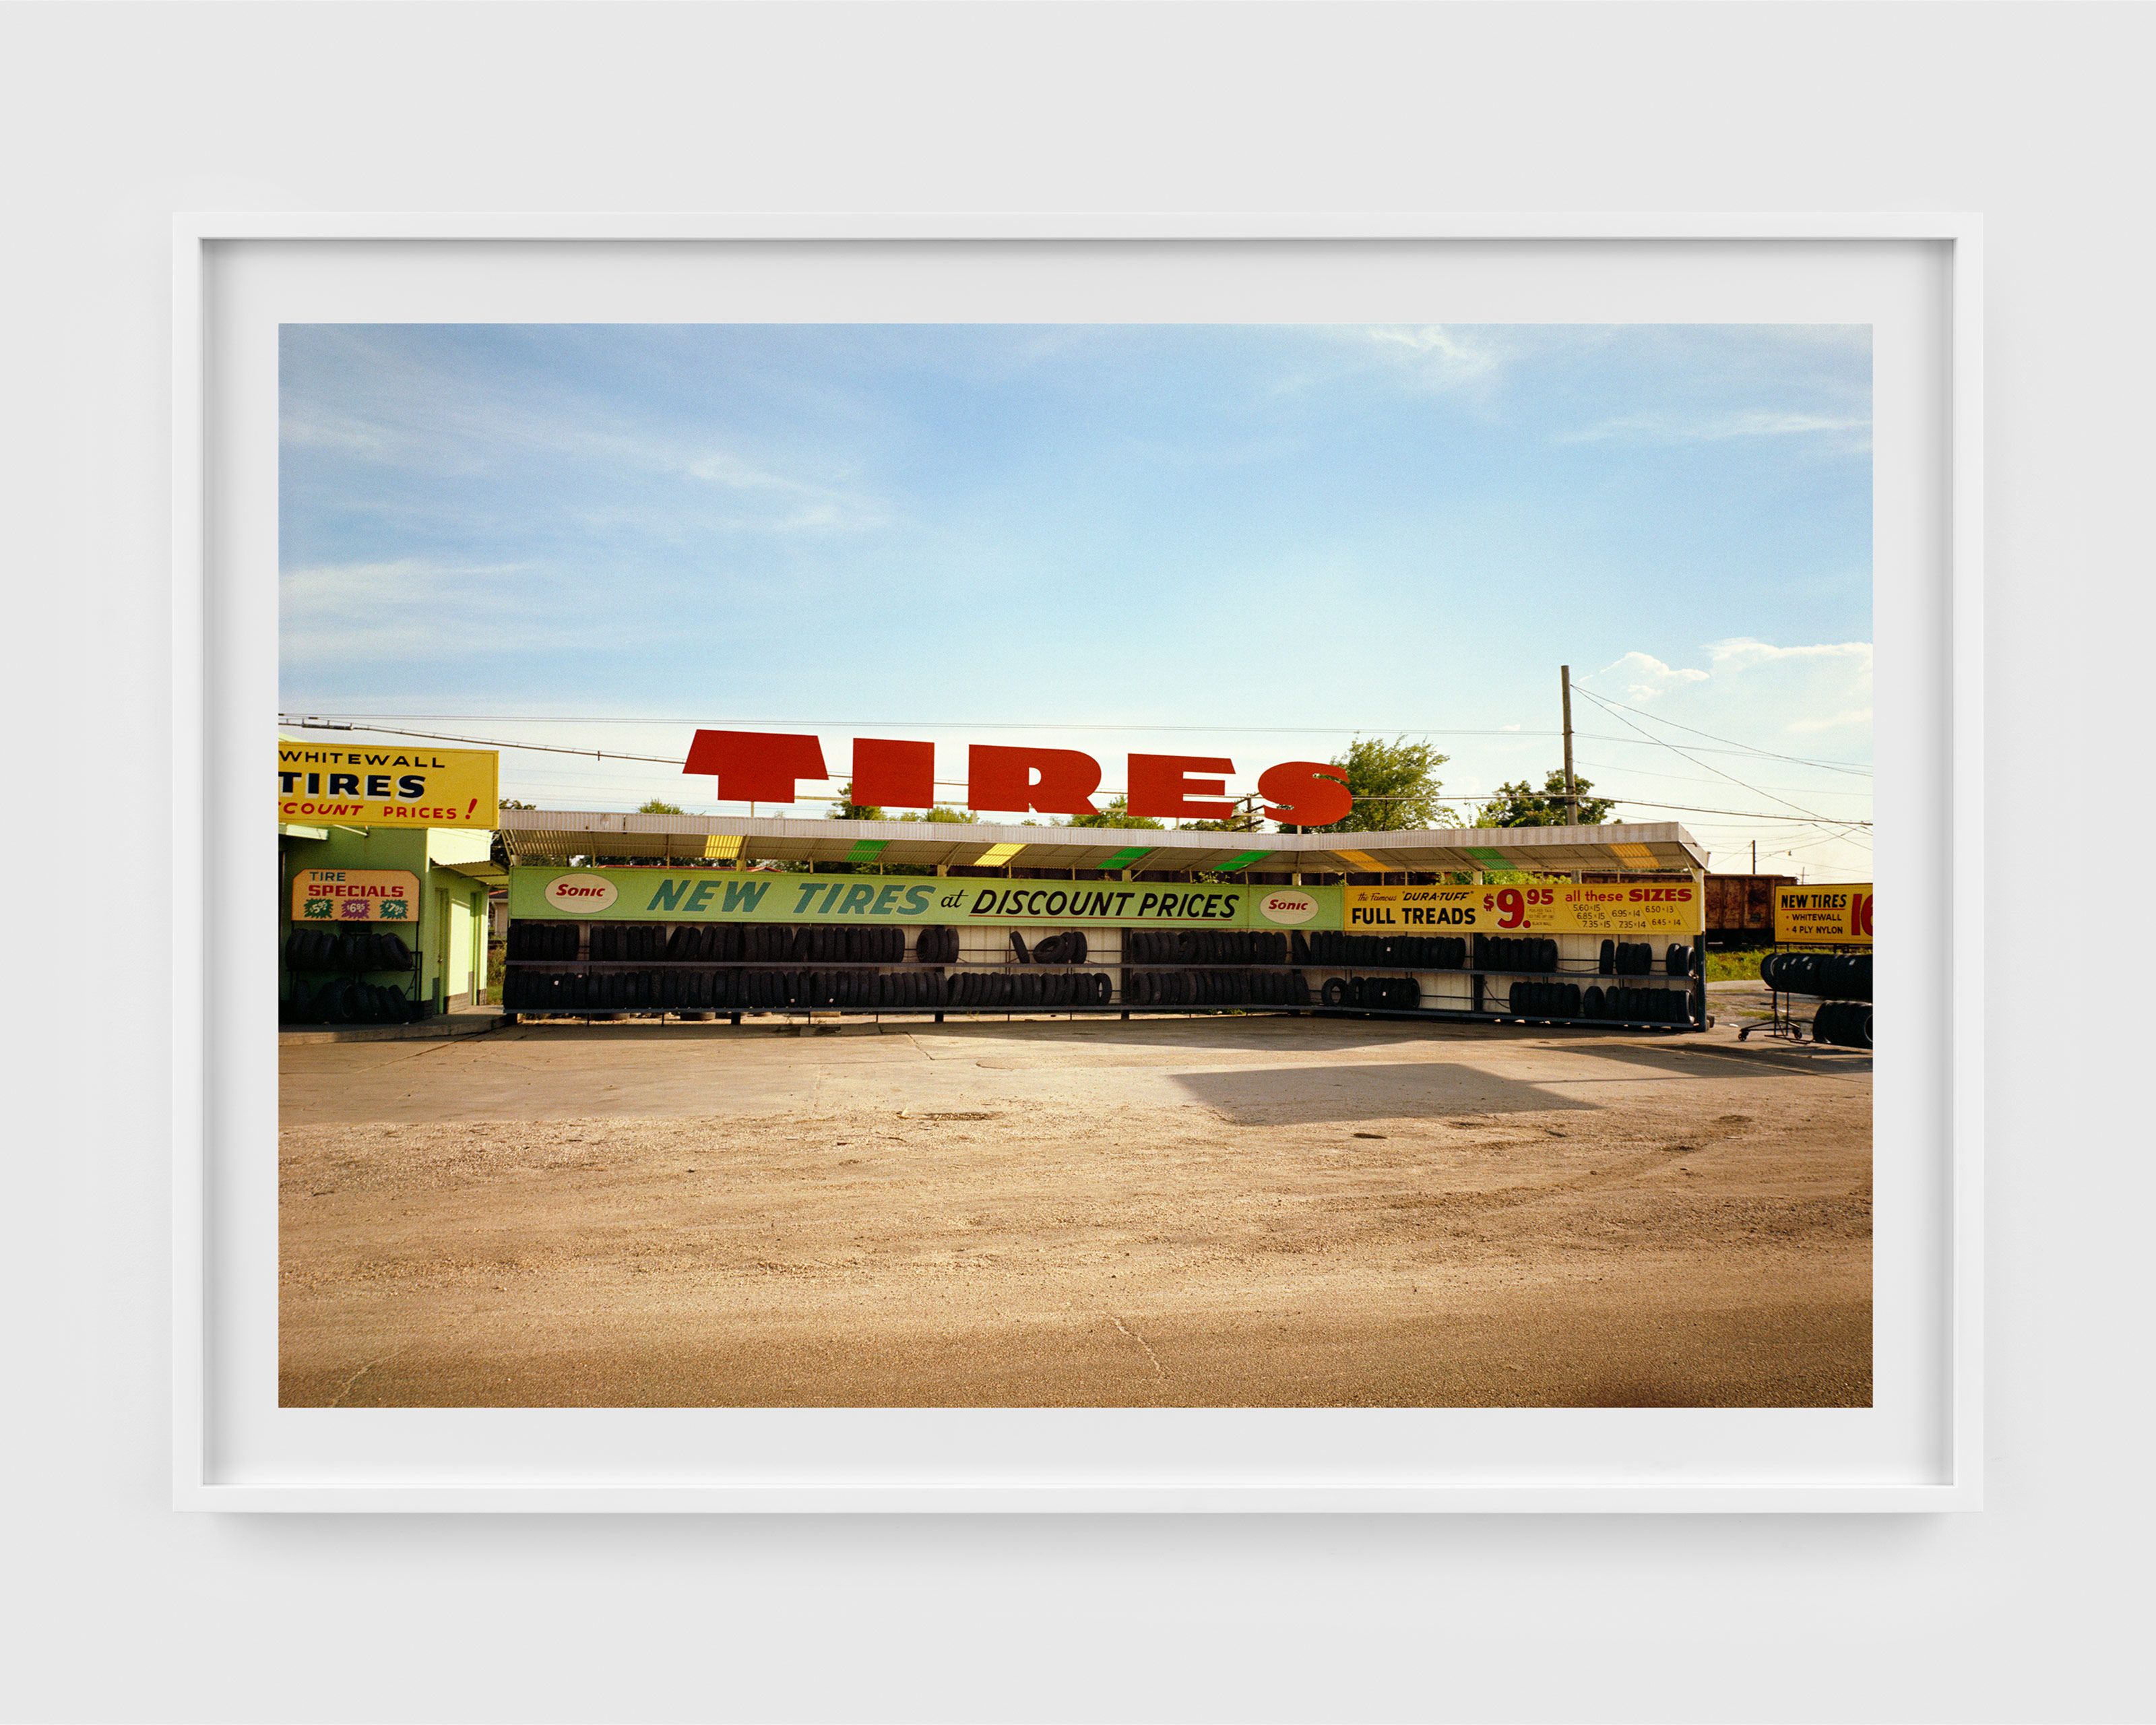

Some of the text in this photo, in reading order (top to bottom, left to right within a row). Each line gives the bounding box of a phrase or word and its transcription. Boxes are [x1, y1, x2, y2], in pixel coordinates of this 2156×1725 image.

[278, 750, 445, 768] WHITEWALL
[683, 728, 1353, 826] TIRES
[278, 772, 426, 802] TIRES
[278, 802, 364, 816] COUNT
[309, 871, 346, 882] TIRE
[308, 885, 404, 898] SPECIALS
[555, 883, 606, 897] Sonic
[1357, 891, 1368, 902] the
[1564, 888, 1692, 902] all these SIZES
[646, 879, 1240, 918] NEW TIRES at DISCOUNT PRICES
[1268, 899, 1308, 910] Sonic
[1781, 894, 1847, 908] NEW TIRES
[1352, 908, 1476, 925] FULL TREADS
[1792, 913, 1842, 921] WHITEWALL
[1792, 926, 1843, 934] 4 PLY NYLON
